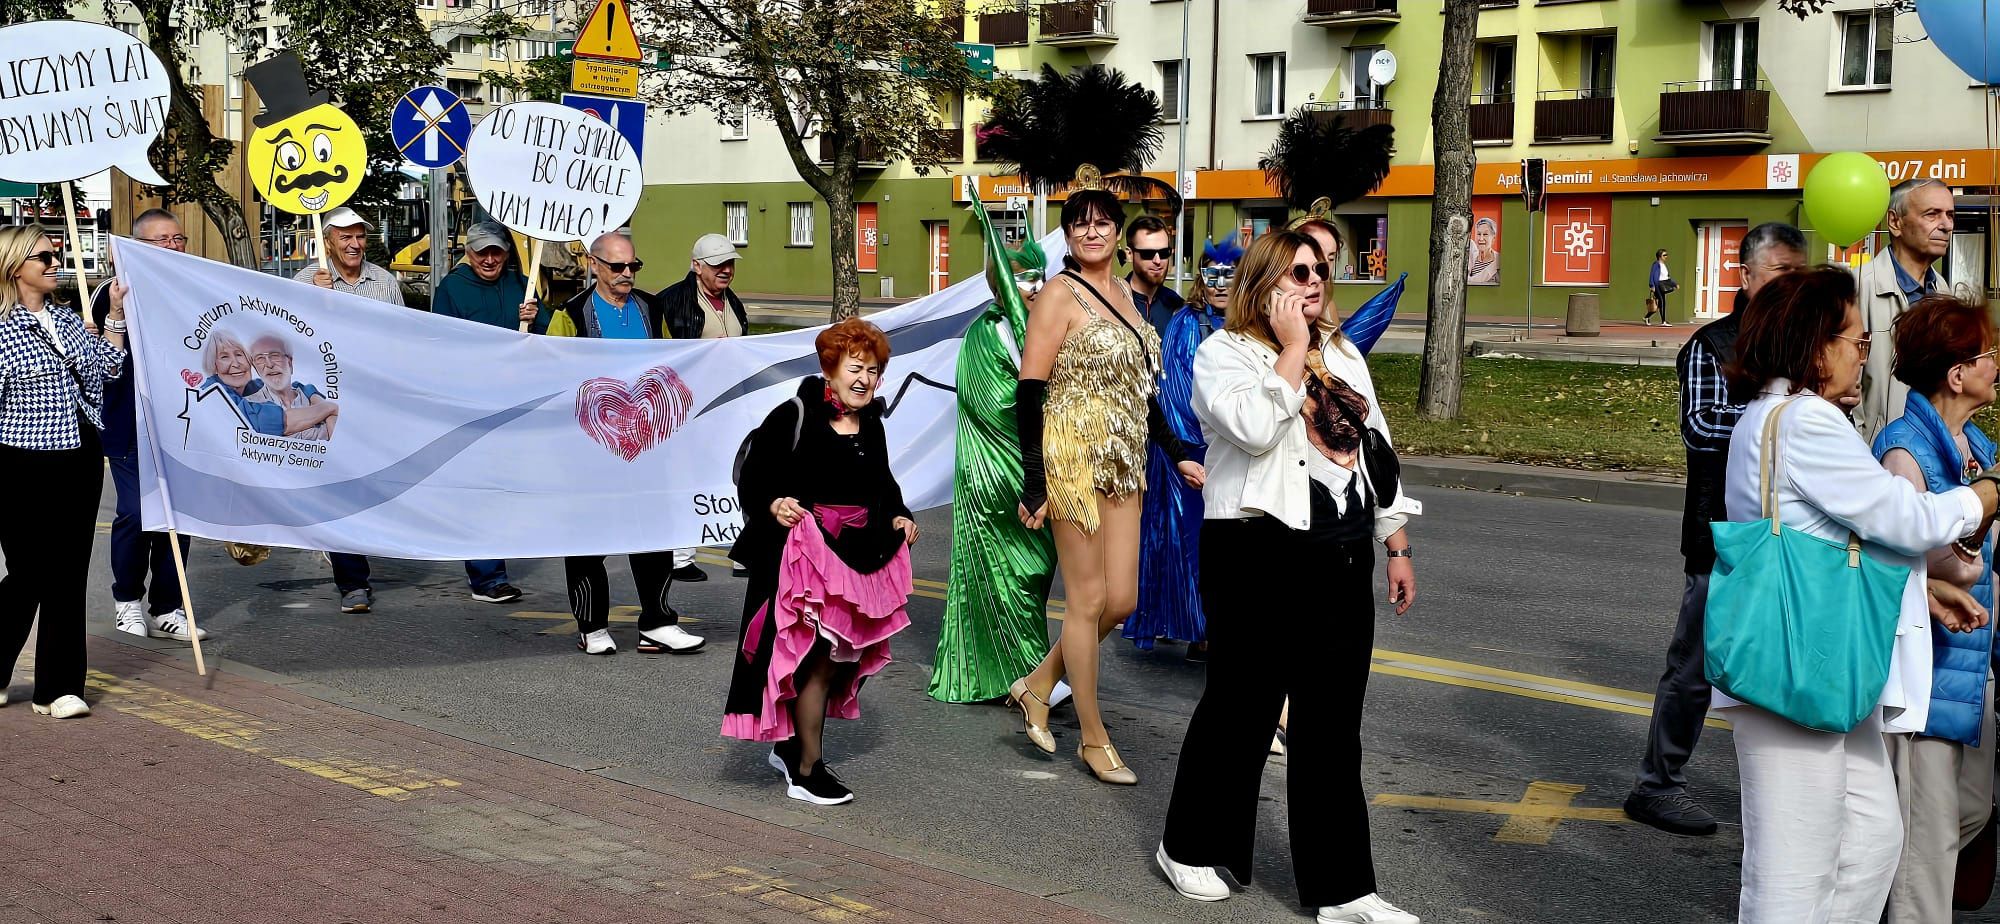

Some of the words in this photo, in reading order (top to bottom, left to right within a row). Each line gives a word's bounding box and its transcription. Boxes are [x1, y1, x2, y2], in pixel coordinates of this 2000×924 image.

[105, 43, 149, 83] LAT
[585, 63, 629, 76] Sygnalizacja
[580, 82, 631, 94] ostrzegawczym
[600, 74, 620, 83] trybie
[104, 95, 168, 138] ŚWIAT
[491, 108, 516, 139] DO
[523, 114, 571, 150] METY
[532, 151, 558, 184] BO
[1546, 170, 1593, 185] Gemini
[1600, 173, 1610, 183] ul.
[1611, 173, 1657, 183] Stanisława
[1658, 171, 1708, 183] Jachowicza
[1929, 158, 1966, 179] dni
[489, 190, 531, 226] NAM
[540, 199, 594, 237] MAŁO
[183, 302, 234, 351] Centrum
[238, 295, 315, 338] Aktywnego
[241, 431, 327, 454] Stowarzyszenie
[241, 447, 285, 466] Aktywny
[287, 453, 324, 469] Senior
